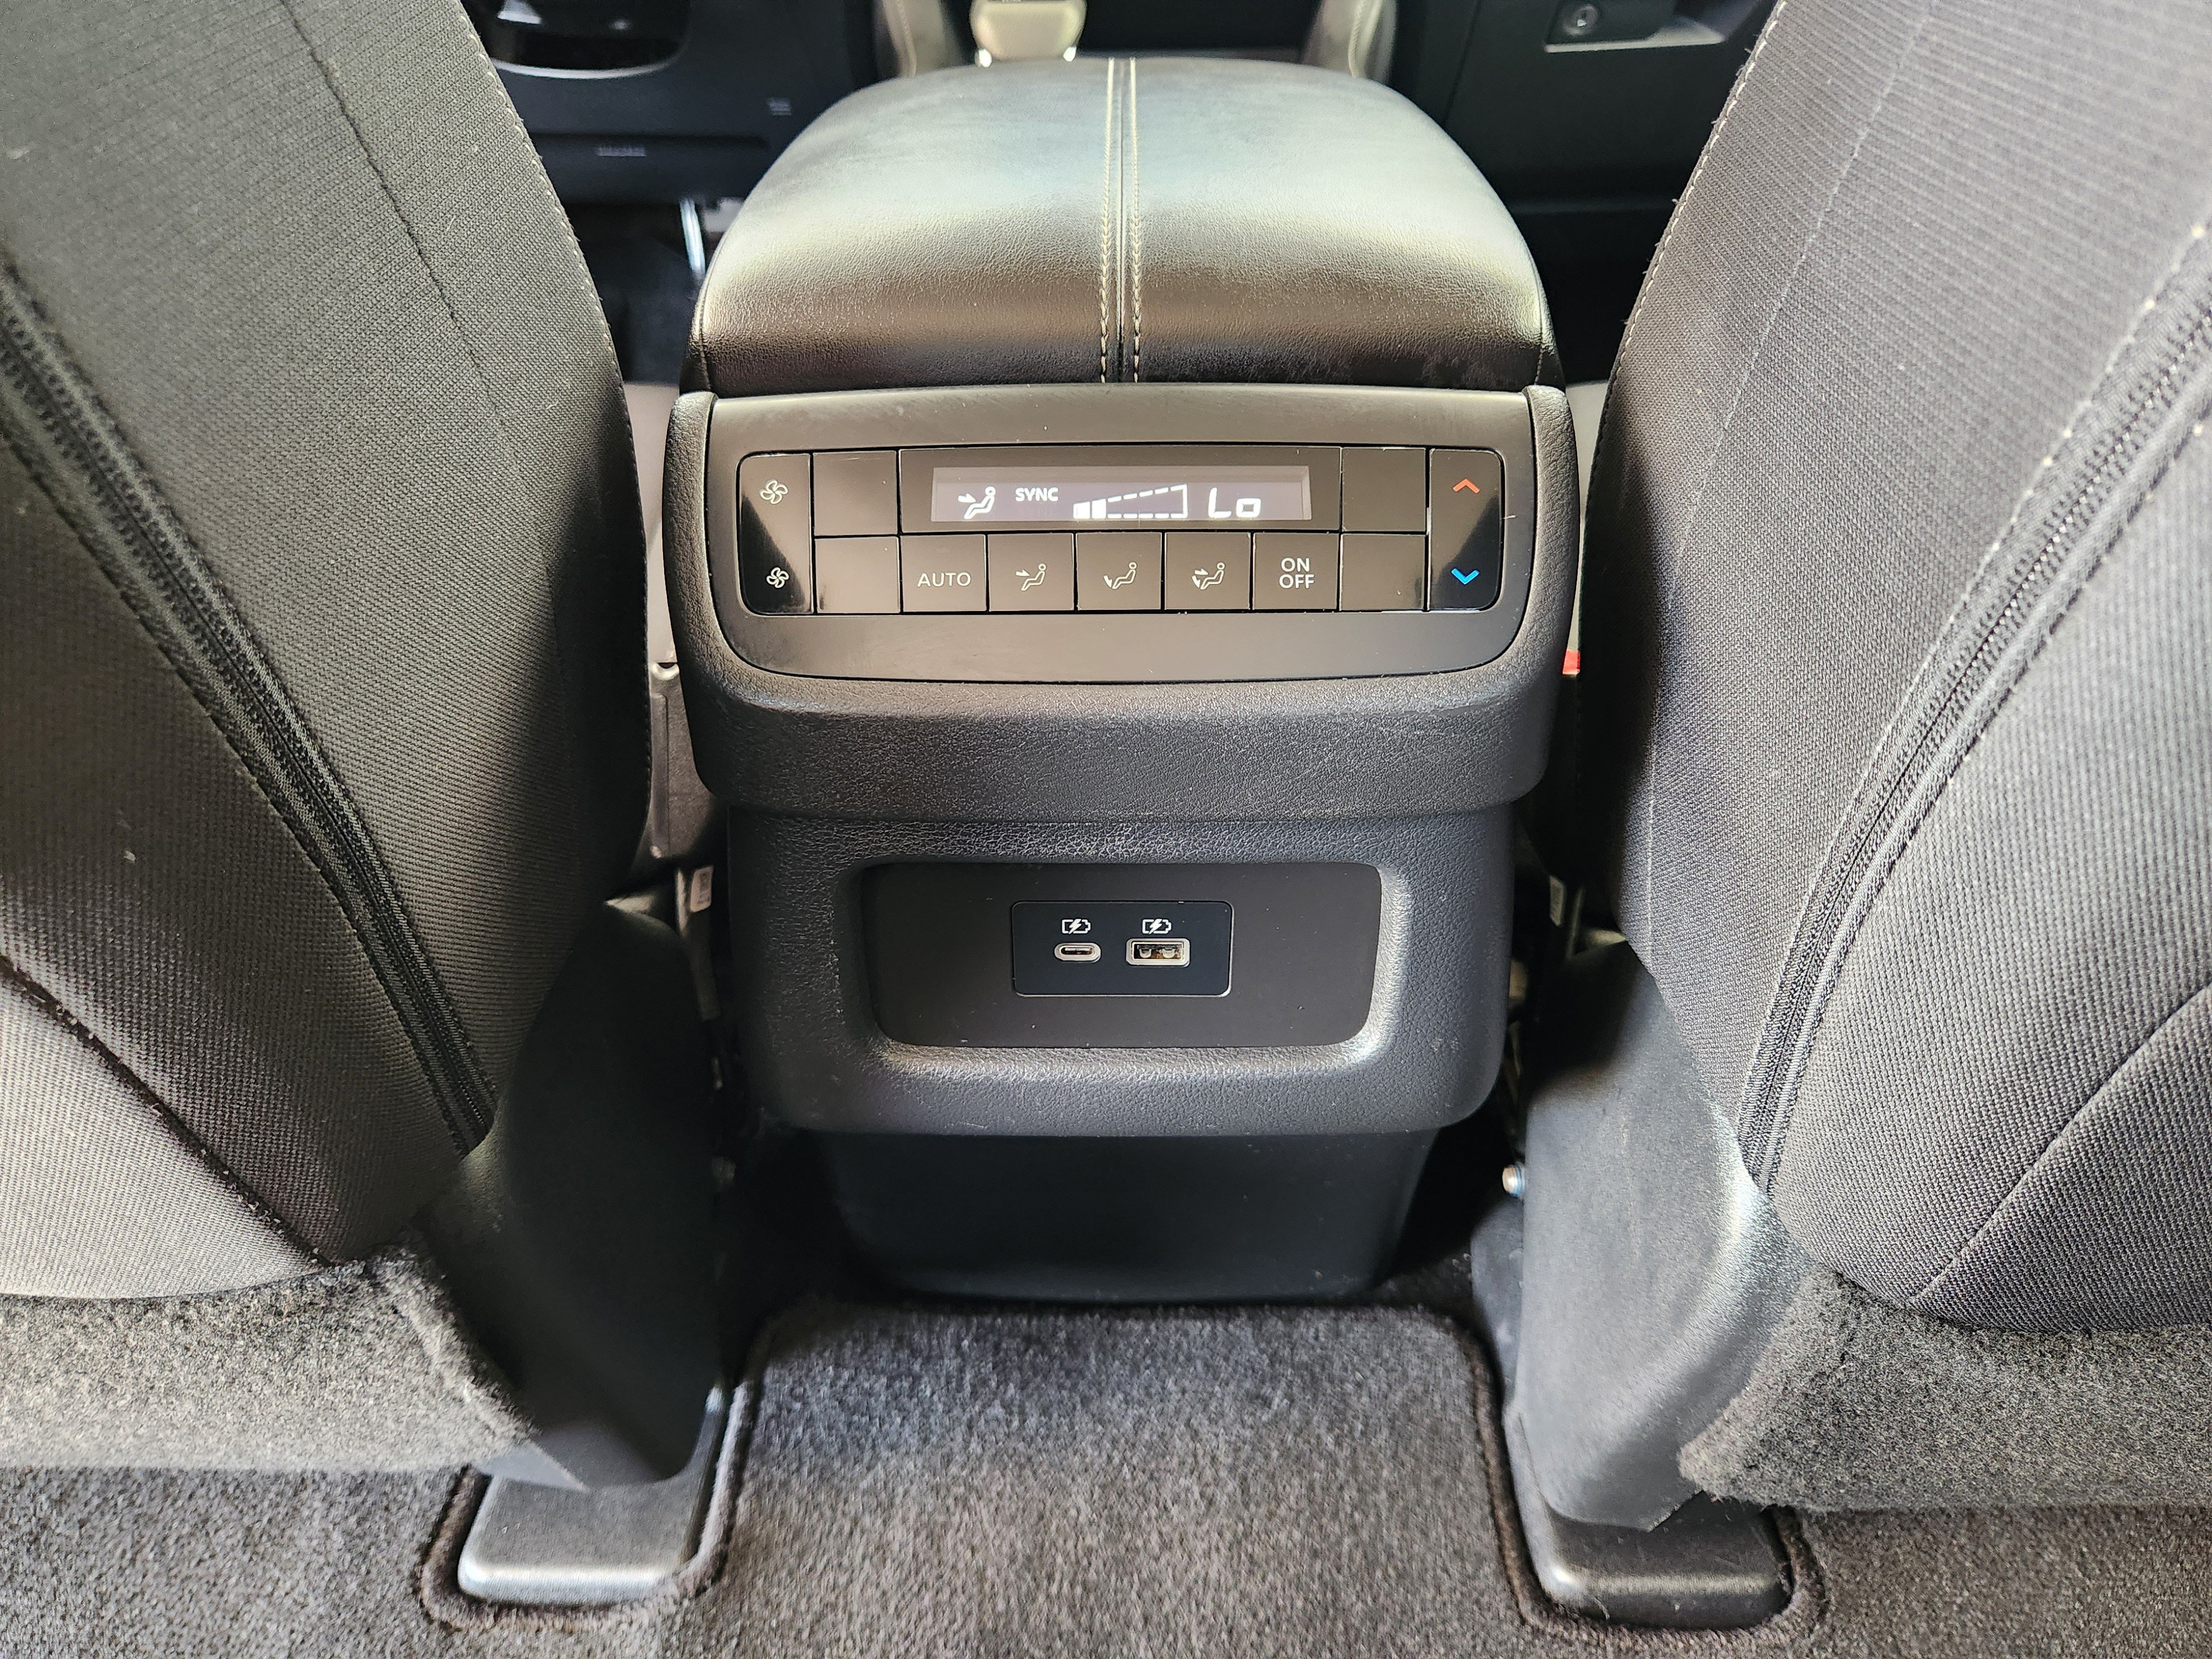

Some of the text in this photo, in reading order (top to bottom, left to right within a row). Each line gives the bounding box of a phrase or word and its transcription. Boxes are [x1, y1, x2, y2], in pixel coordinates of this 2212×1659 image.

[1015, 487, 1059, 502] SYNC
[1208, 487, 1261, 518] Lo
[1281, 557, 1310, 572] ON
[917, 572, 971, 587] AUTO
[1279, 575, 1314, 589] OFF
